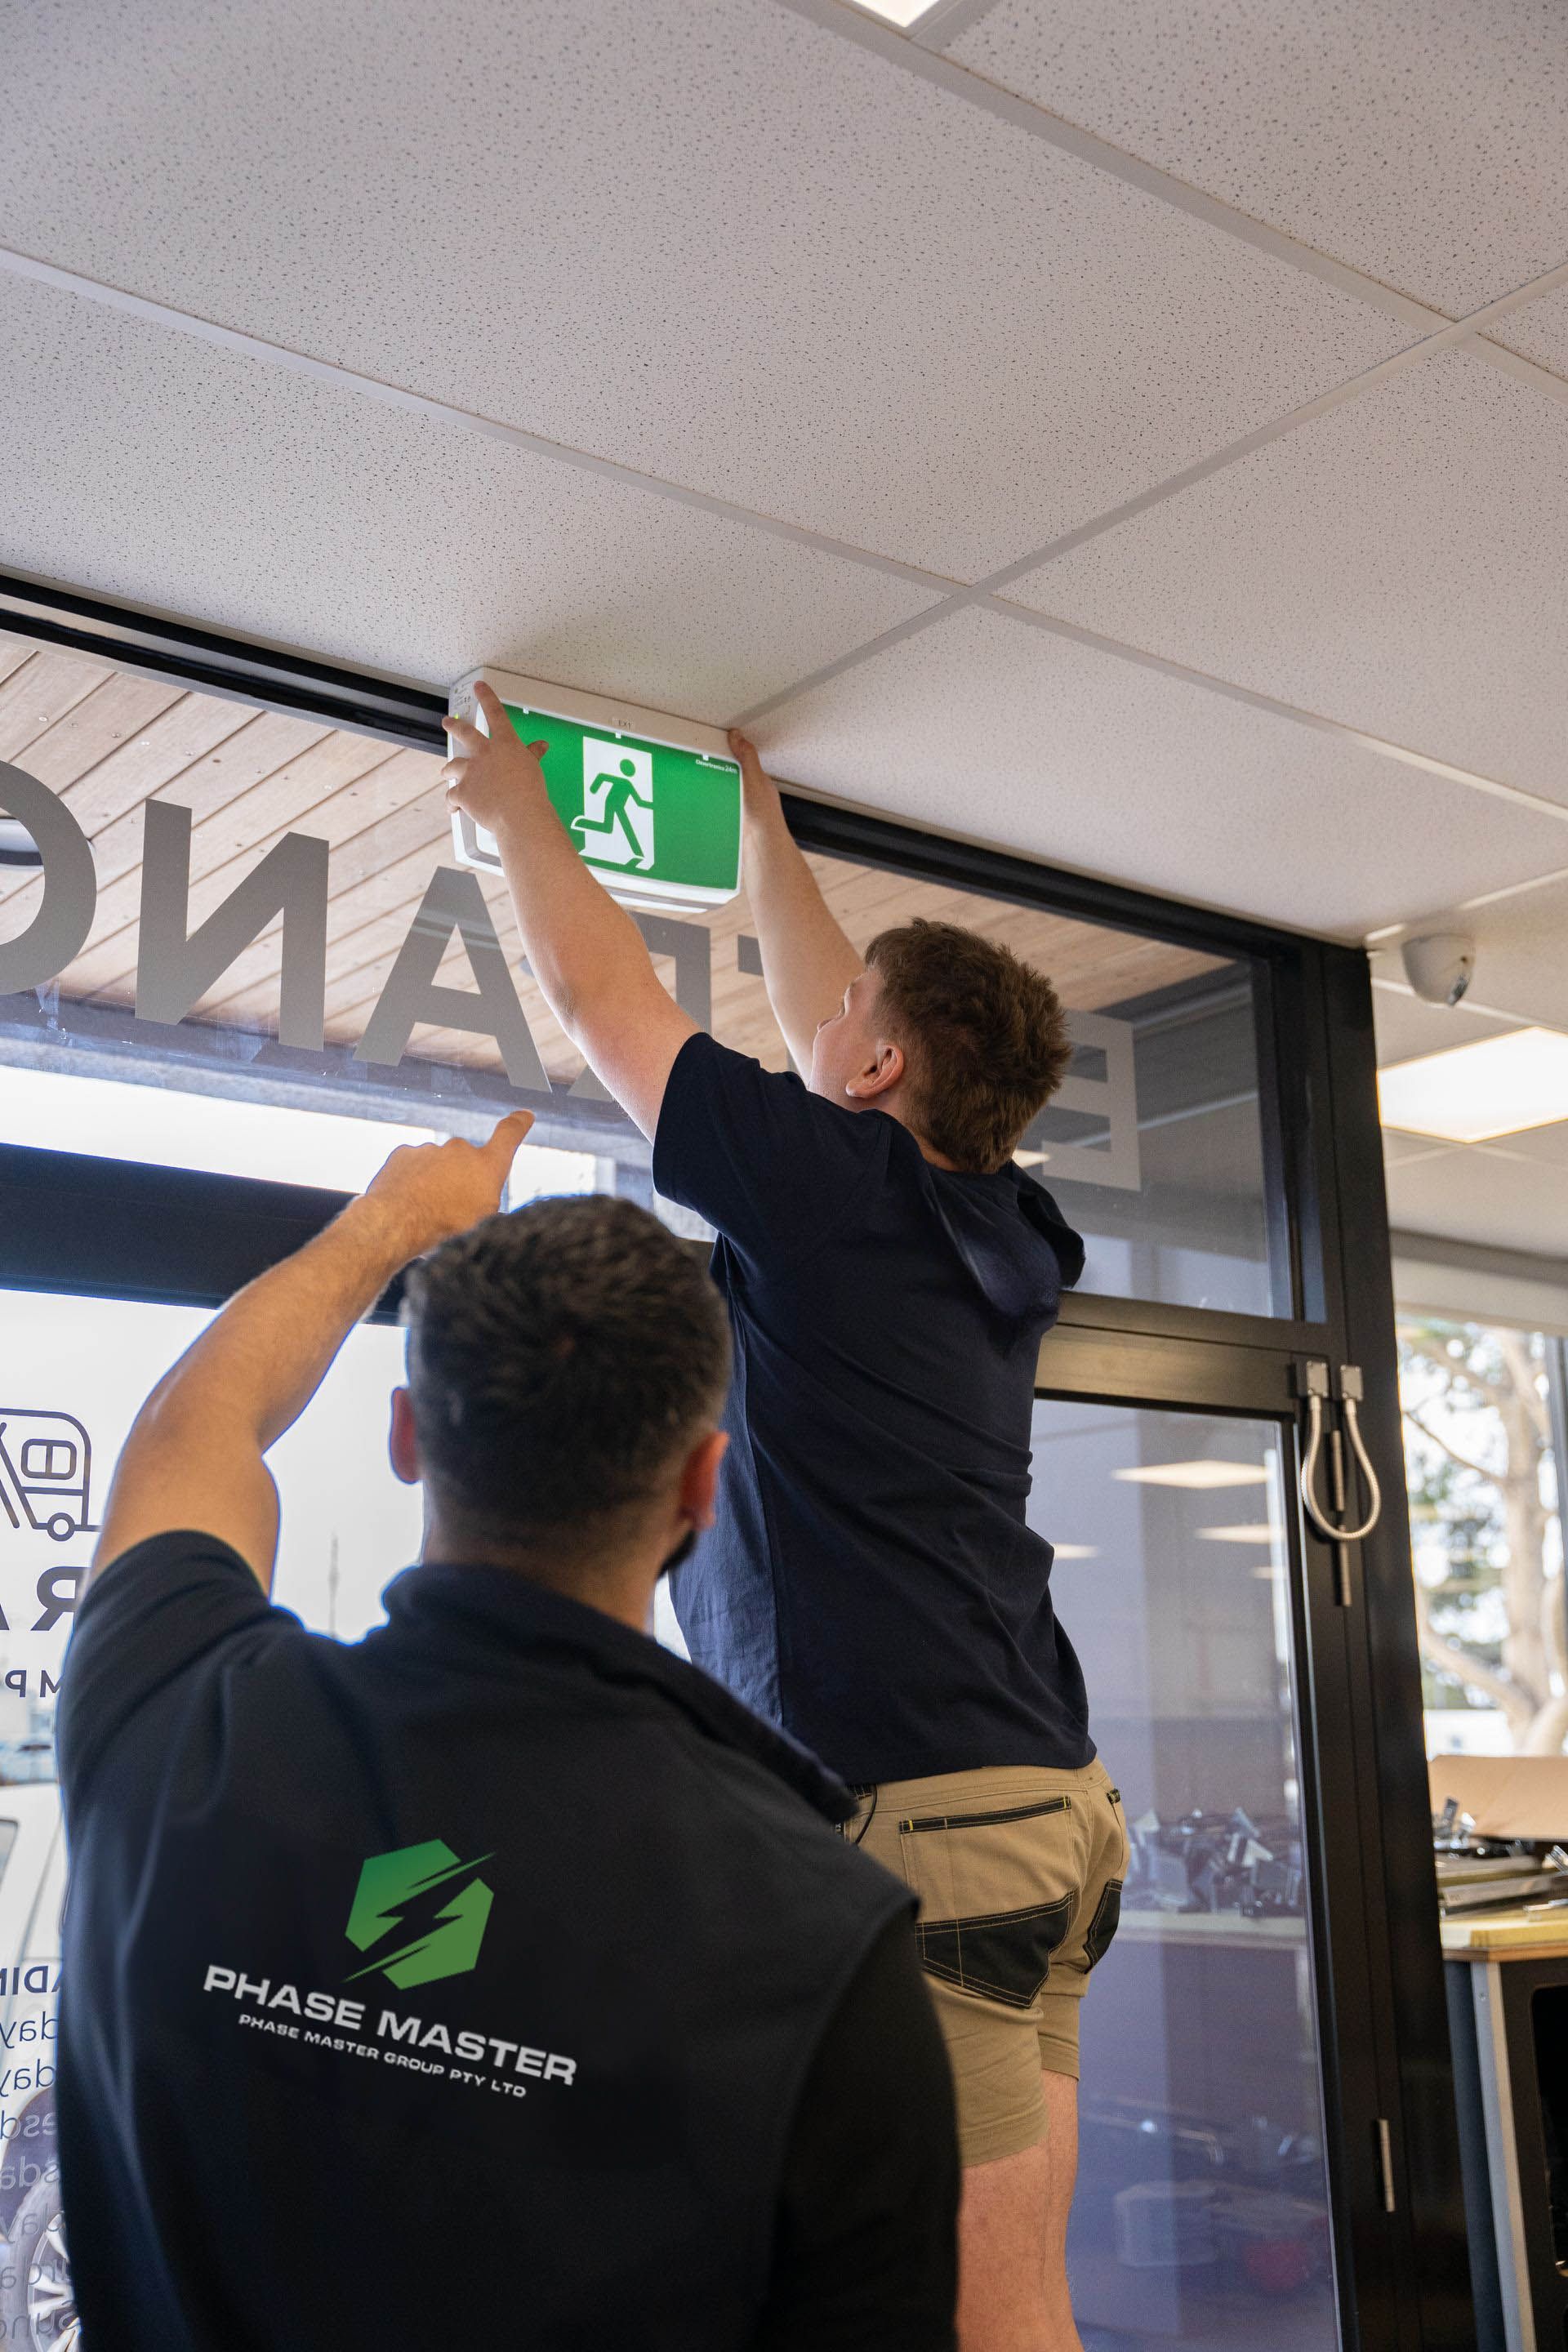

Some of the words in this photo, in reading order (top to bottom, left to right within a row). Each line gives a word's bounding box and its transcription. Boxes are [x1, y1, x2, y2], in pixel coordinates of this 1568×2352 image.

[203, 1964, 366, 2030] PHASE
[376, 2010, 578, 2087] MASTER
[238, 2013, 300, 2039] PHASE
[304, 2030, 380, 2060] MASTER
[383, 2051, 445, 2075] GROUP
[449, 2069, 487, 2087] PTY
[491, 2078, 527, 2098] LTD
